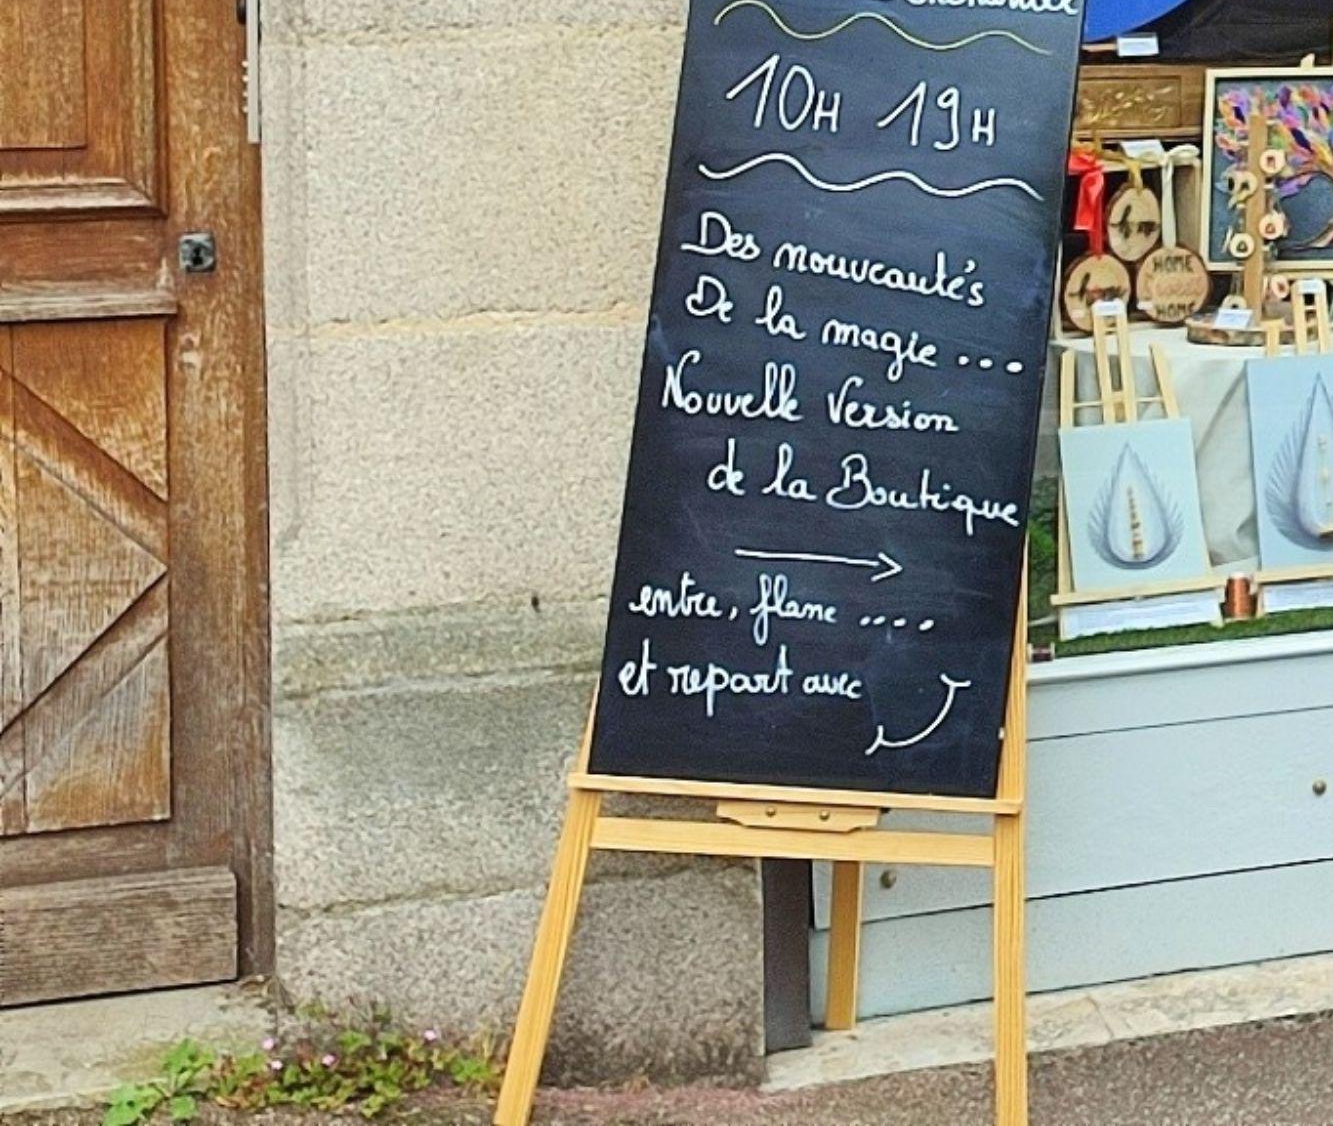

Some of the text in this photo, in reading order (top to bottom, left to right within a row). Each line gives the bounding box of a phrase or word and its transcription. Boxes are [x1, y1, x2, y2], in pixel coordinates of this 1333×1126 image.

[680, 211, 985, 307] Des nouveautés
[1153, 255, 1194, 272] HOME
[685, 274, 734, 323] De
[754, 286, 806, 340] la
[821, 315, 938, 381] magie
[660, 351, 959, 432] Nouvelle Version
[706, 438, 1021, 535] de la Boutique
[617, 637, 865, 717] et repart avec
